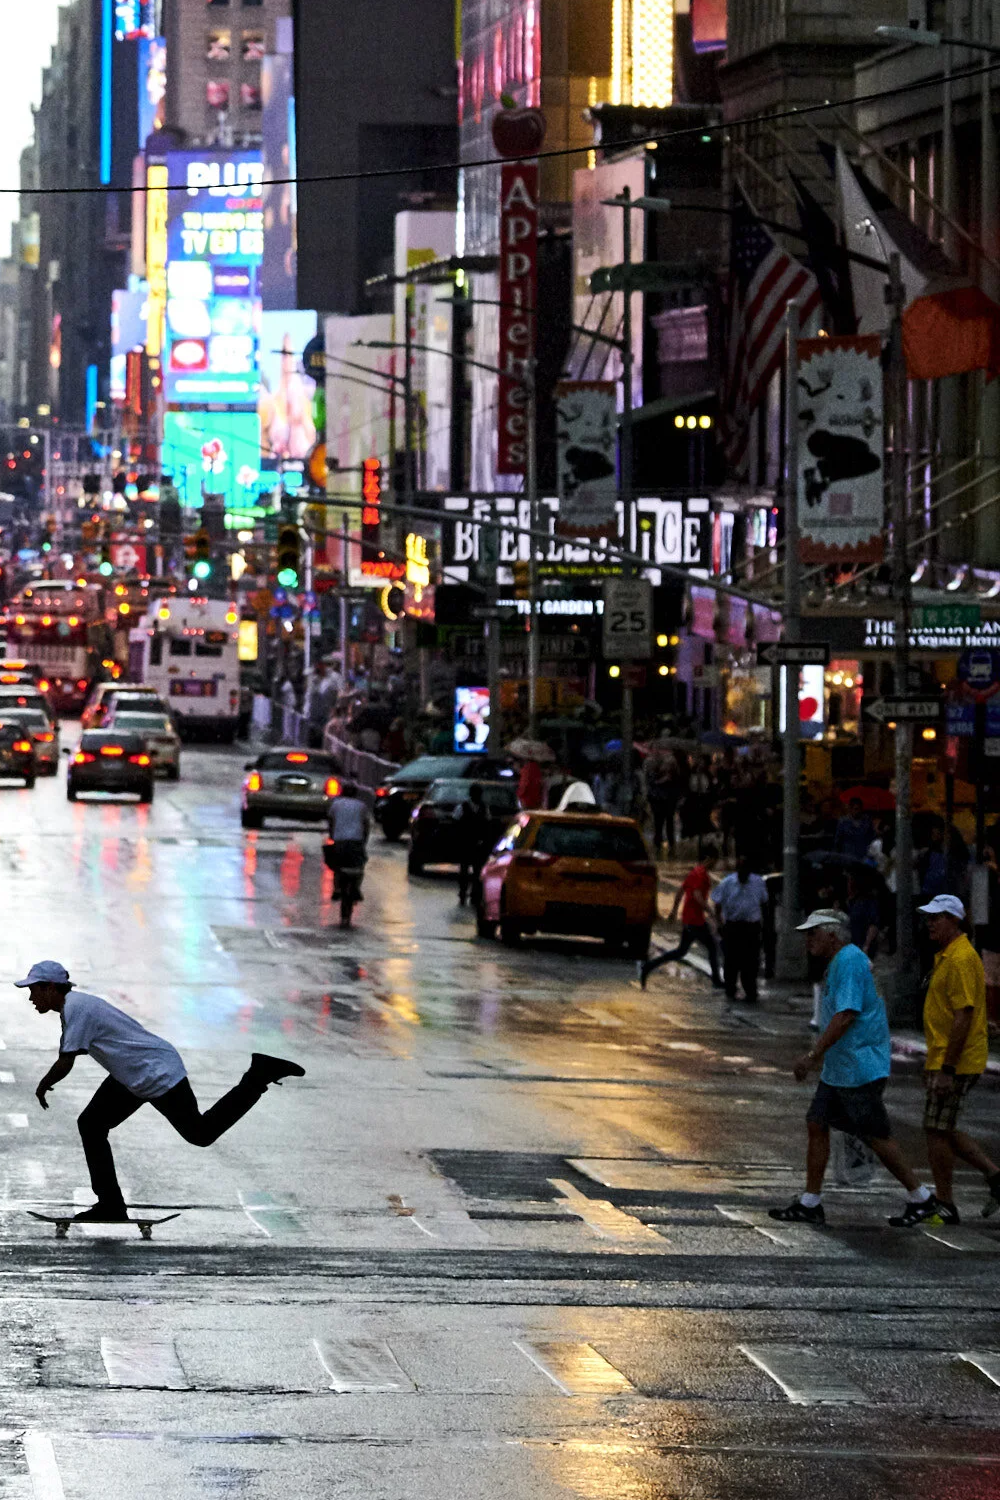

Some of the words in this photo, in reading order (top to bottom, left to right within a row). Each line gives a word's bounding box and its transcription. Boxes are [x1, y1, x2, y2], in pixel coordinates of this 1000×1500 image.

[542, 600, 594, 615] GARDEN
[611, 611, 646, 632] 25
[864, 619, 896, 635] THE
[864, 635, 878, 647] AT
[918, 635, 961, 648] SQUARE
[907, 704, 933, 716] WAY
